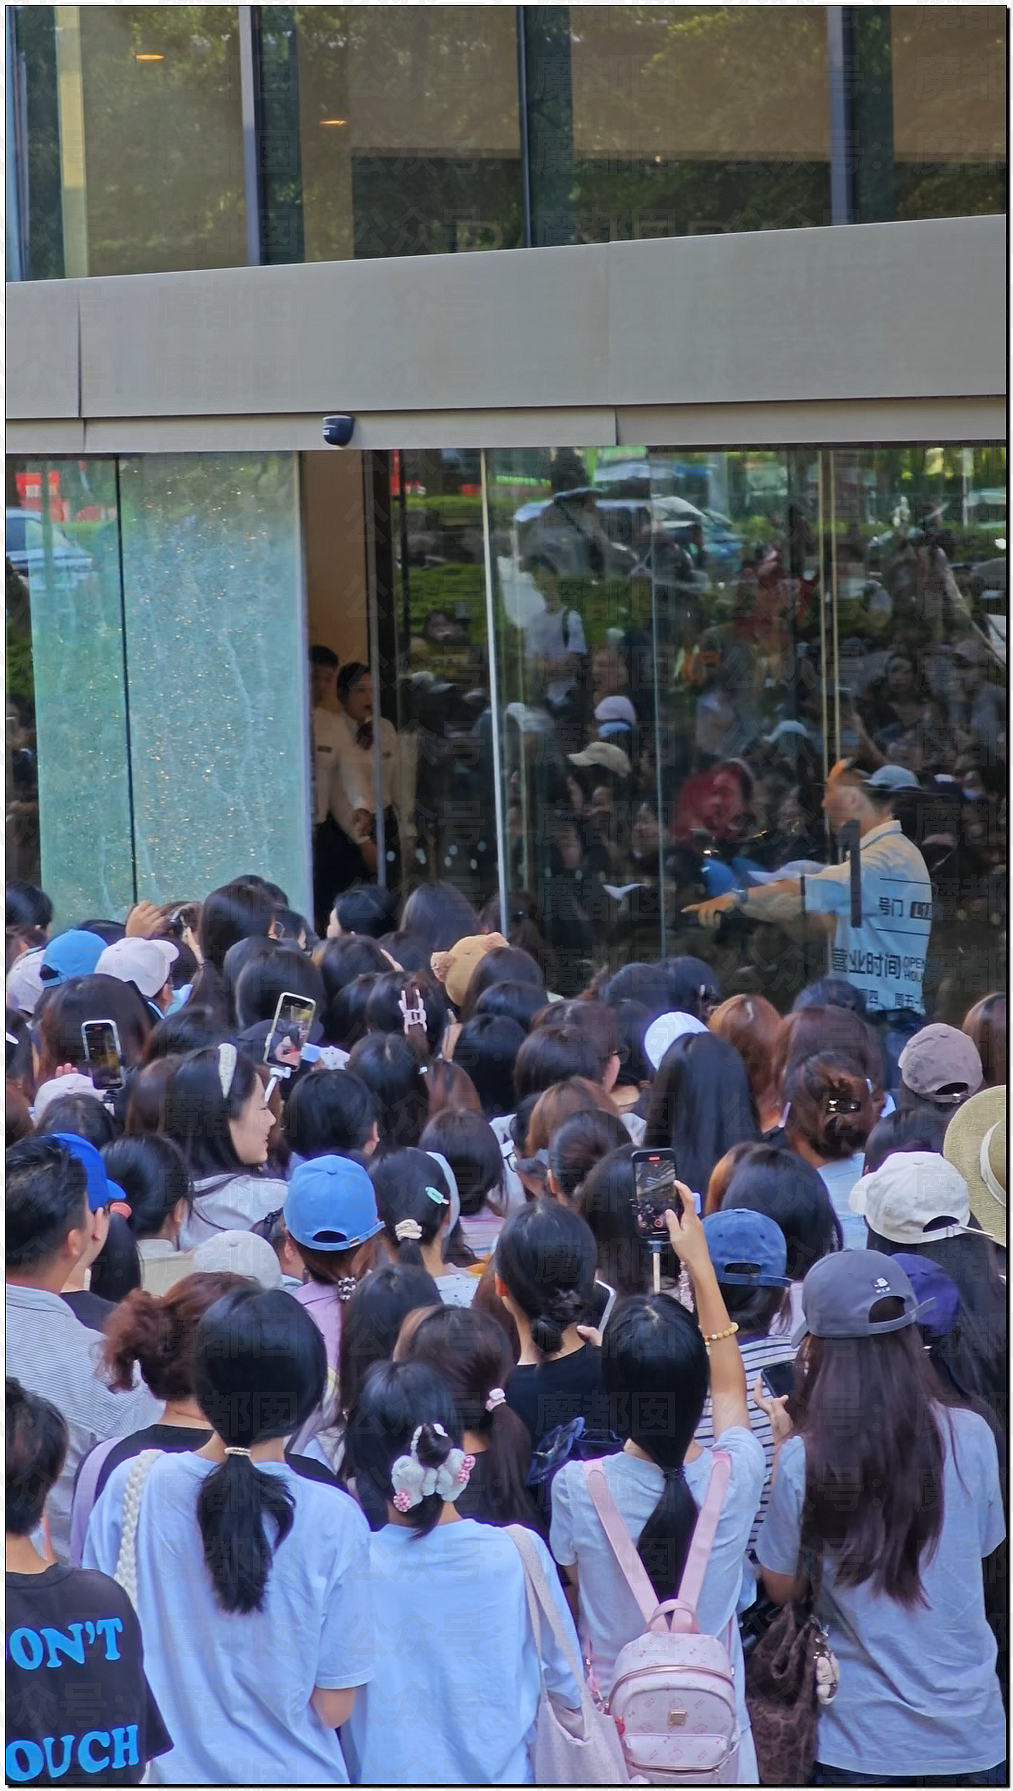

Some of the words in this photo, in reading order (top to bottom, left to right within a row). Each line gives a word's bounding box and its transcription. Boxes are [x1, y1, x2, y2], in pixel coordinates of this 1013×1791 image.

[879, 896, 903, 917] 号门
[913, 903, 932, 919] L1
[832, 947, 902, 980] 营业时间
[9, 1617, 124, 1670] ON'T
[6, 1724, 140, 1782] OUCH
